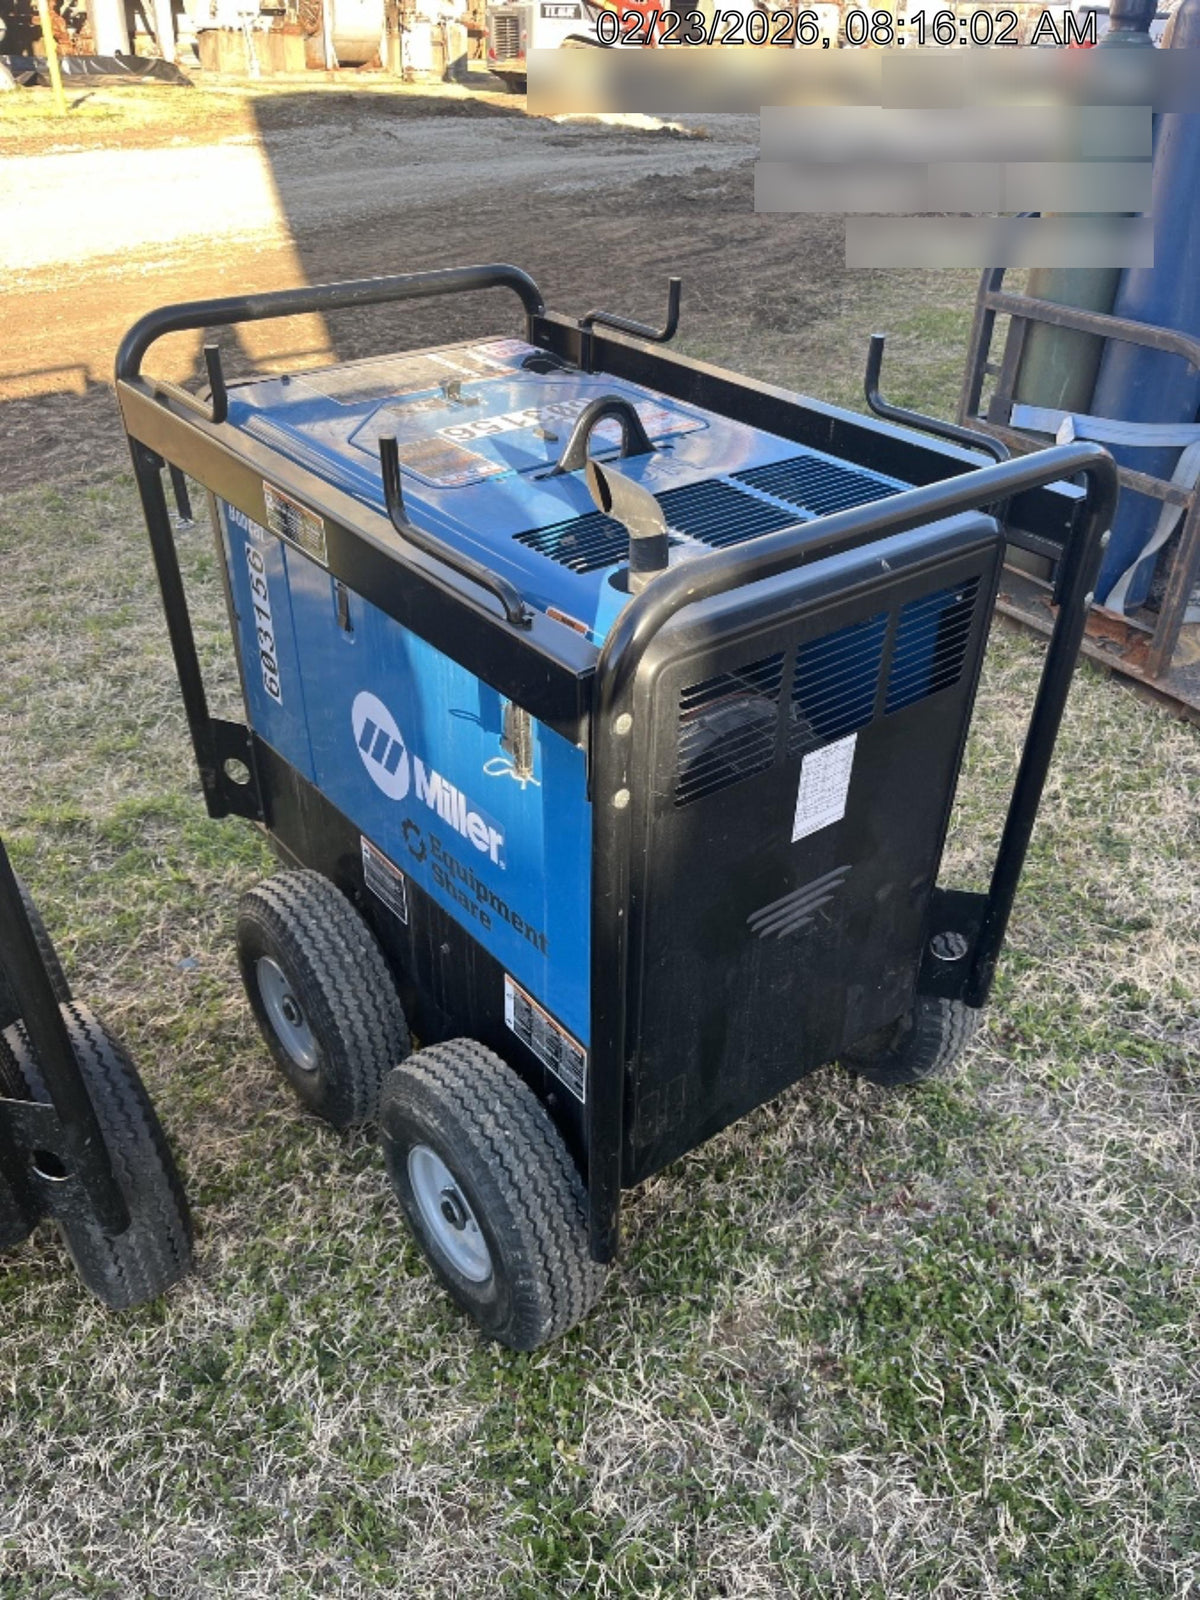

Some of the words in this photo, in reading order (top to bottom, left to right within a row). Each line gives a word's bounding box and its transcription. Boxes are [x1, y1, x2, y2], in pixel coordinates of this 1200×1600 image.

[246, 547, 280, 698] 603156
[413, 754, 504, 865] Miller
[428, 831, 549, 956] Equipment
[431, 862, 492, 931] Share
